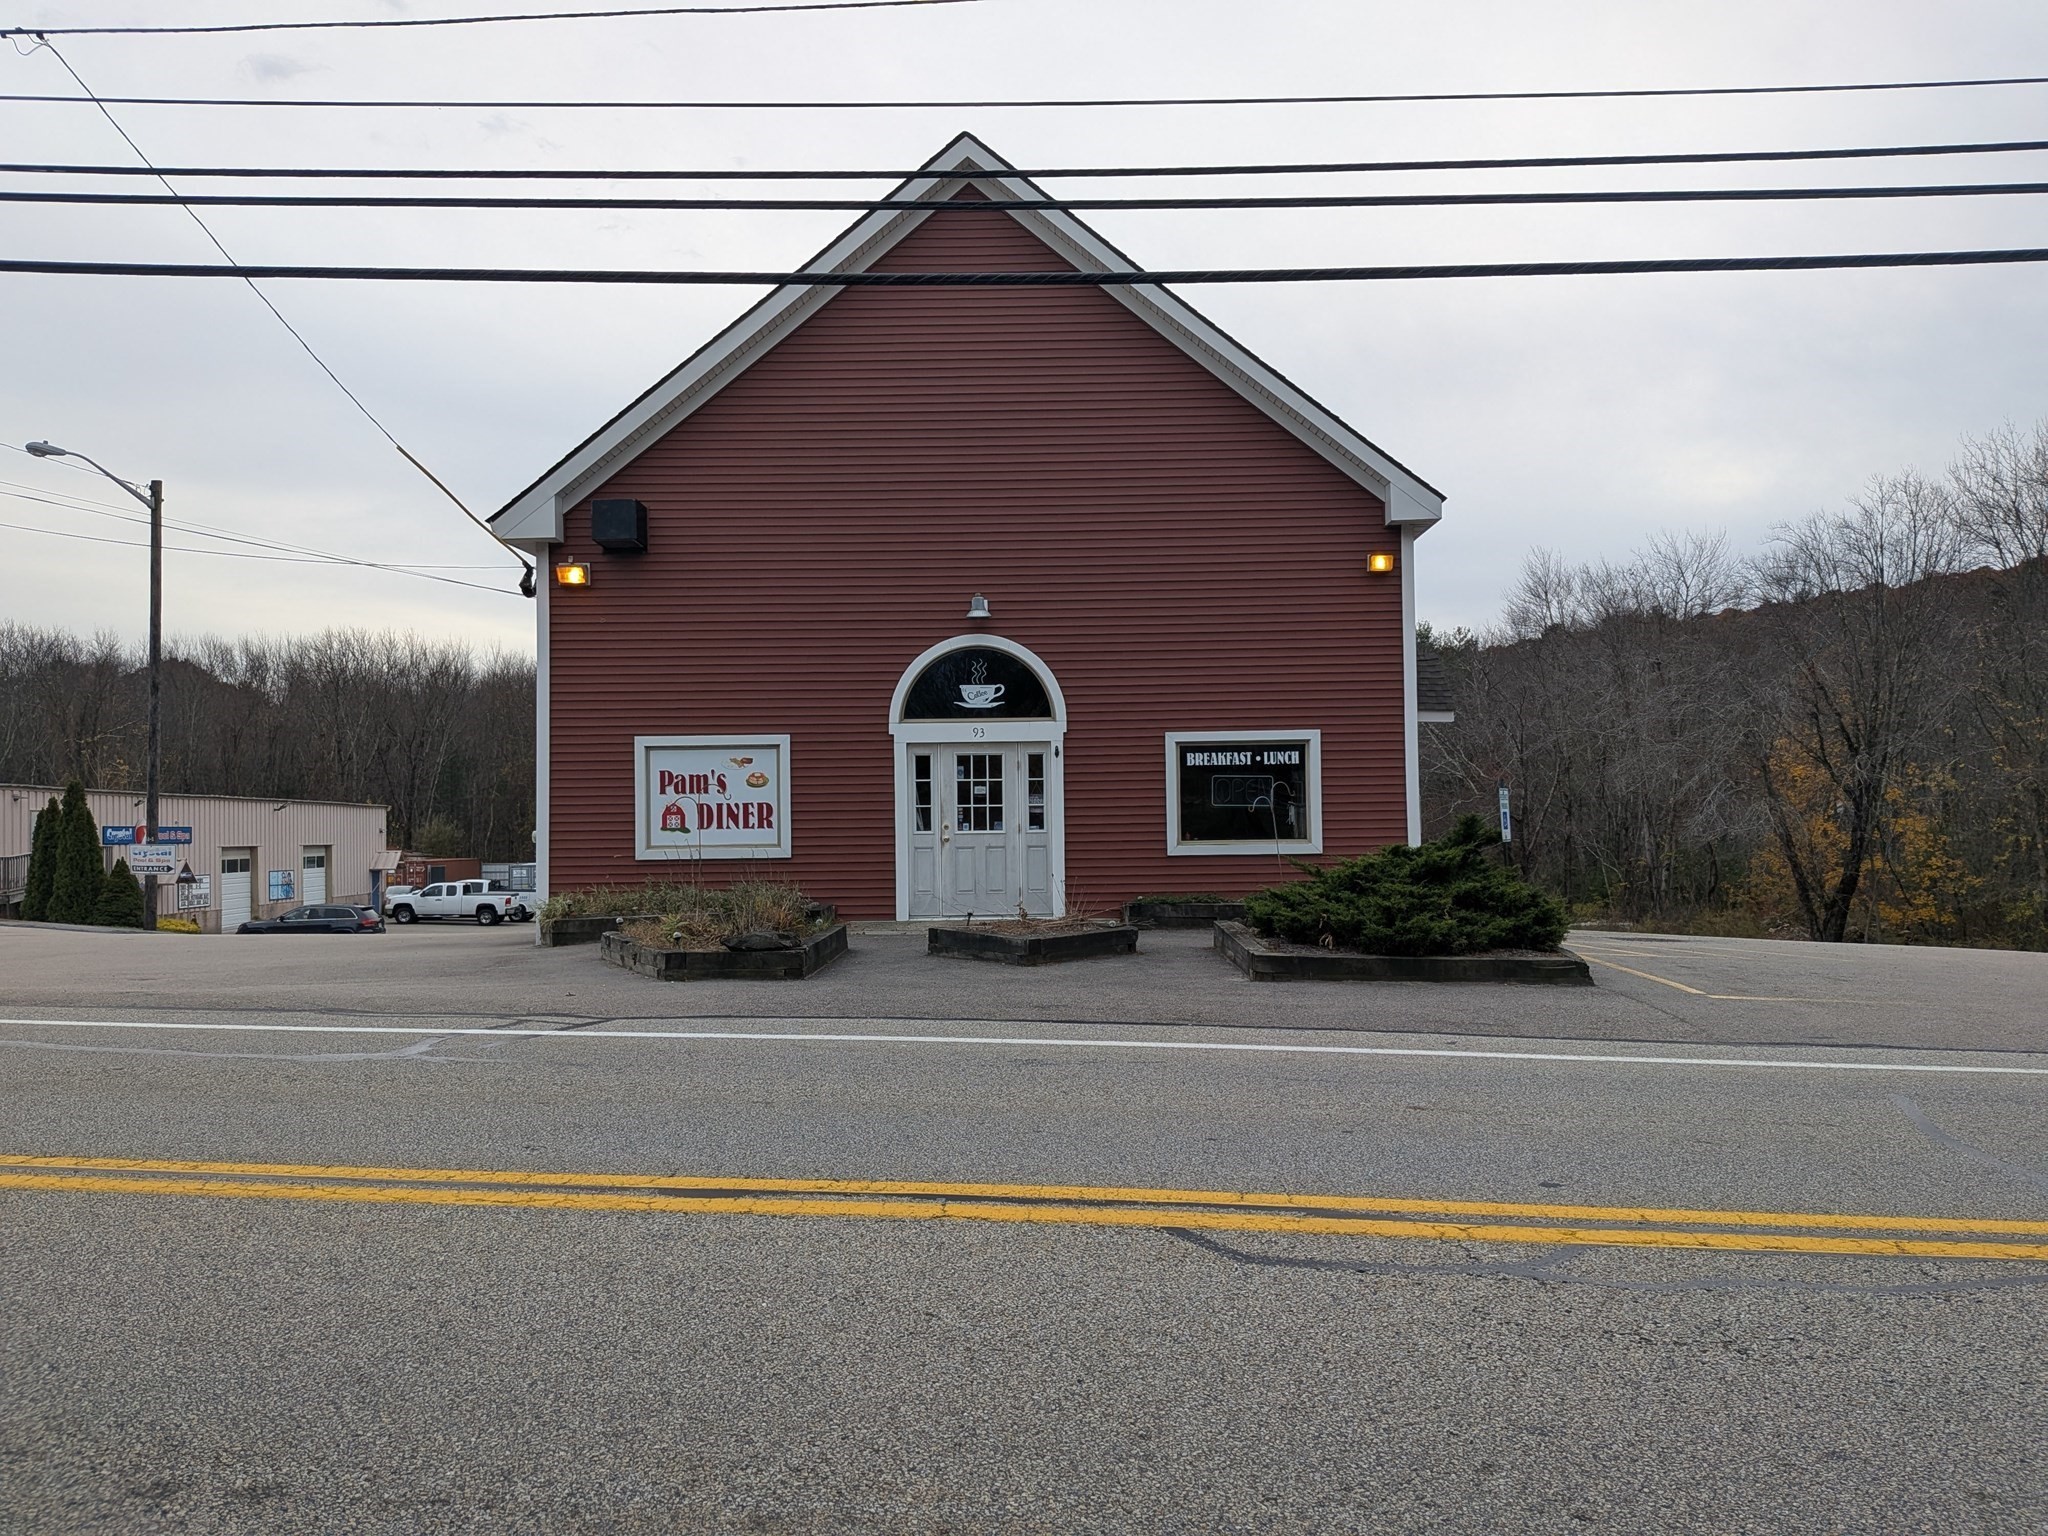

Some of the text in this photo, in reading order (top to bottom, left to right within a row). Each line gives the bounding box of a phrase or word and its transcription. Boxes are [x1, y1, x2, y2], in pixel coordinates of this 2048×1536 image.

[972, 727, 985, 738] 93
[1186, 750, 1300, 766] BREAKFAST LUNCH
[658, 769, 727, 795] Pam's
[697, 802, 774, 830] DINER
